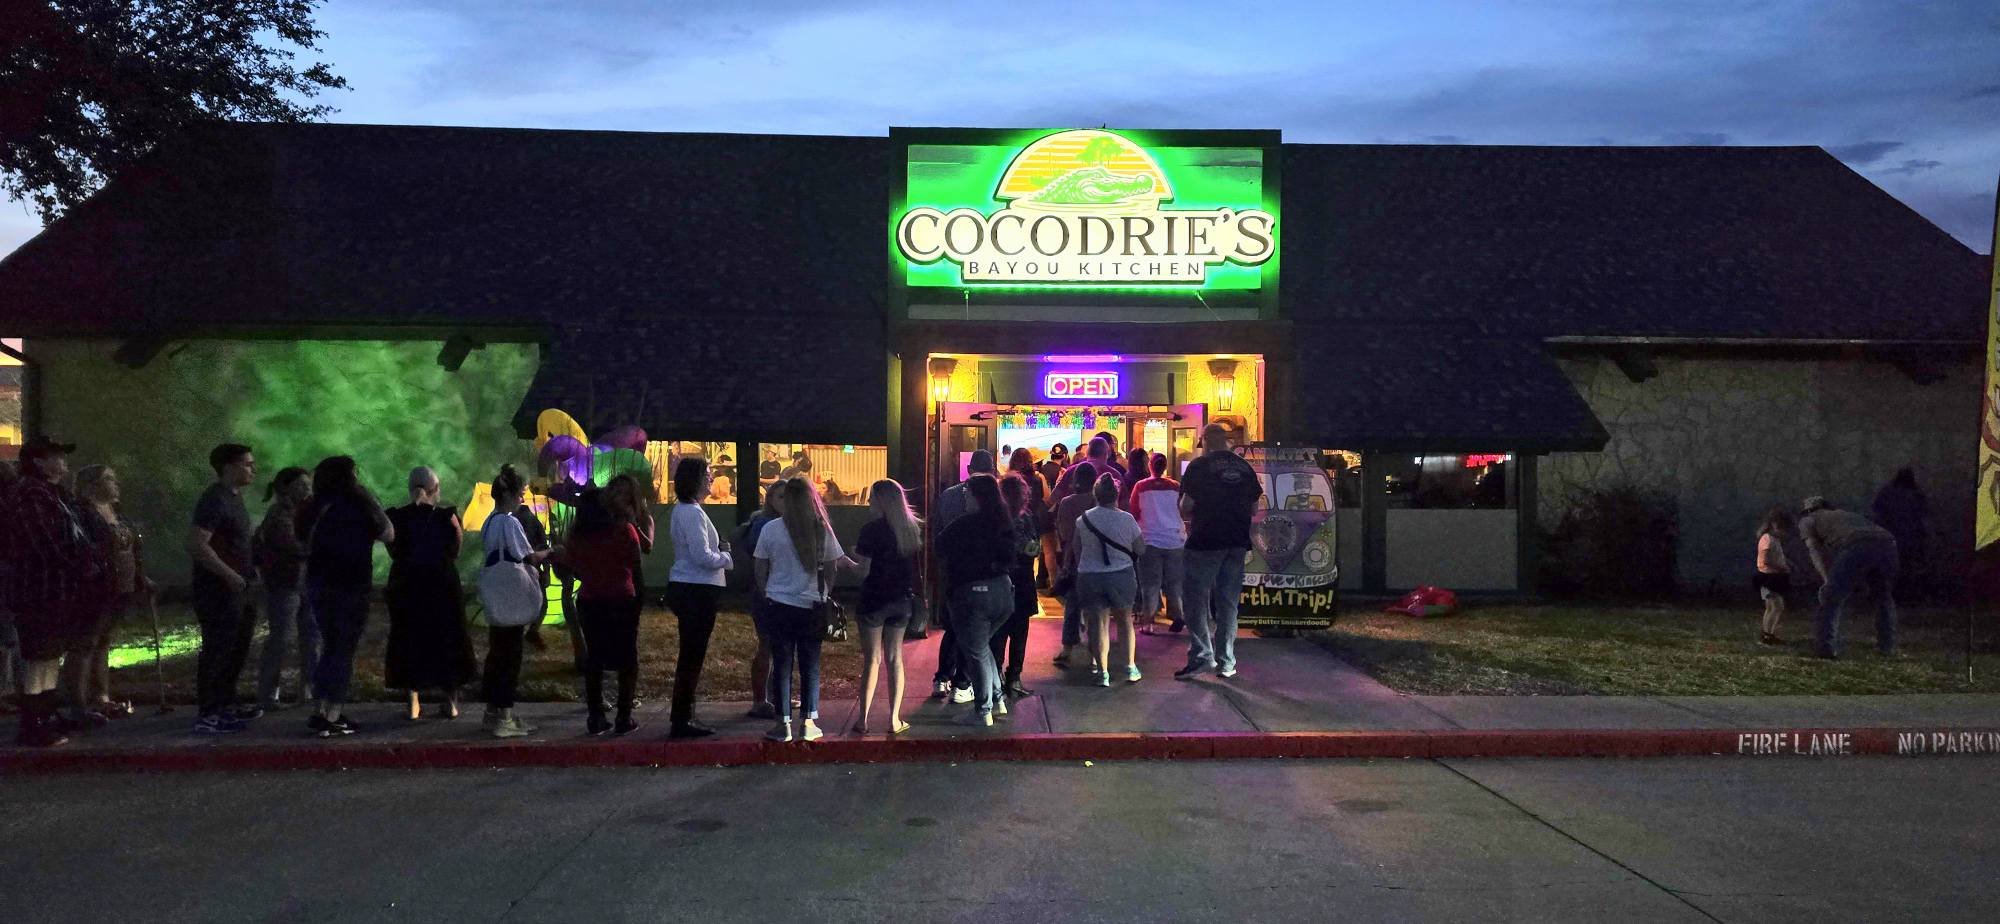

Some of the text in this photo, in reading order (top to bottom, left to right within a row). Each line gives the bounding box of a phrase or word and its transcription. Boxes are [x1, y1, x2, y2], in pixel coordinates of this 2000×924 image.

[904, 213, 1271, 257] COCODRIE'S
[969, 261, 1201, 276] BAYOU KITCHEN
[1051, 377, 1114, 396] OPEN
[1271, 590, 1284, 606] A
[1284, 589, 1334, 614] Trip!
[1258, 618, 1280, 626] Butter
[1794, 732, 1851, 756] LANE
[1898, 731, 1926, 754] NO
